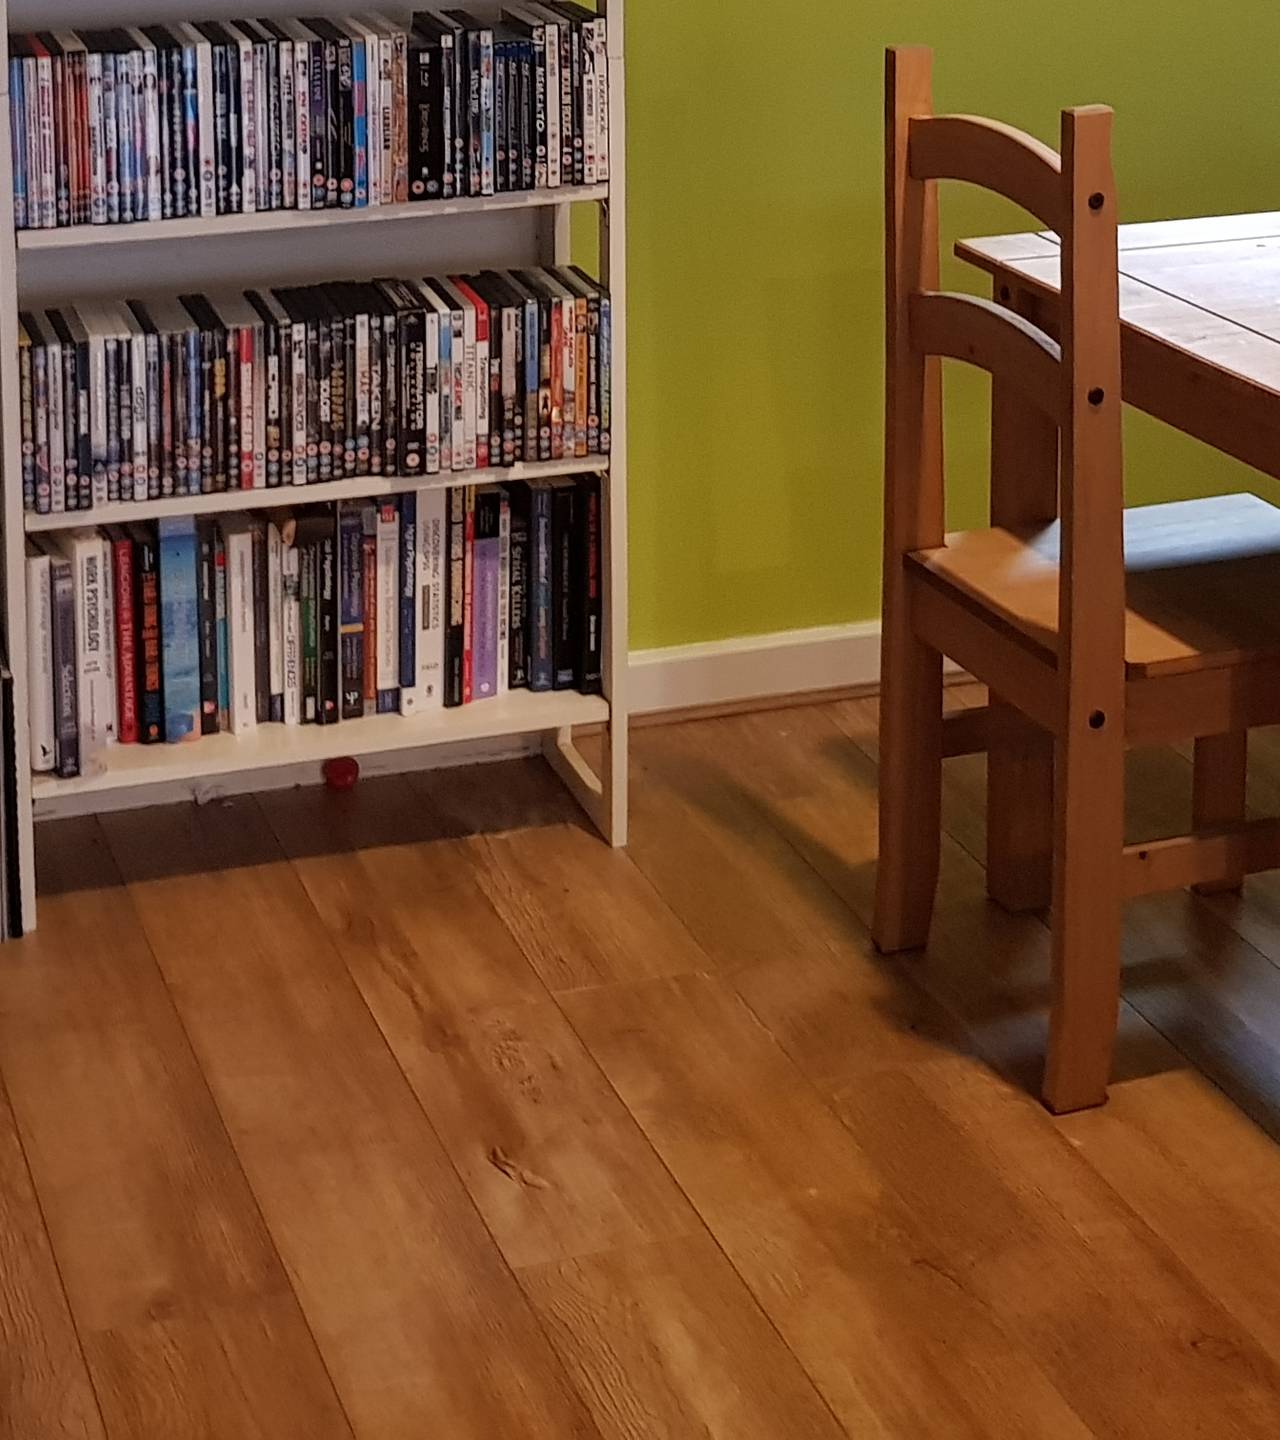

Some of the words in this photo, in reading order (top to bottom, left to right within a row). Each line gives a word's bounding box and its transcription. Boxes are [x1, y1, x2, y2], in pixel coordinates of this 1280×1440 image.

[370, 361, 382, 431] TAKEN
[415, 341, 424, 430] TERMINATOR
[86, 555, 98, 583] WORK
